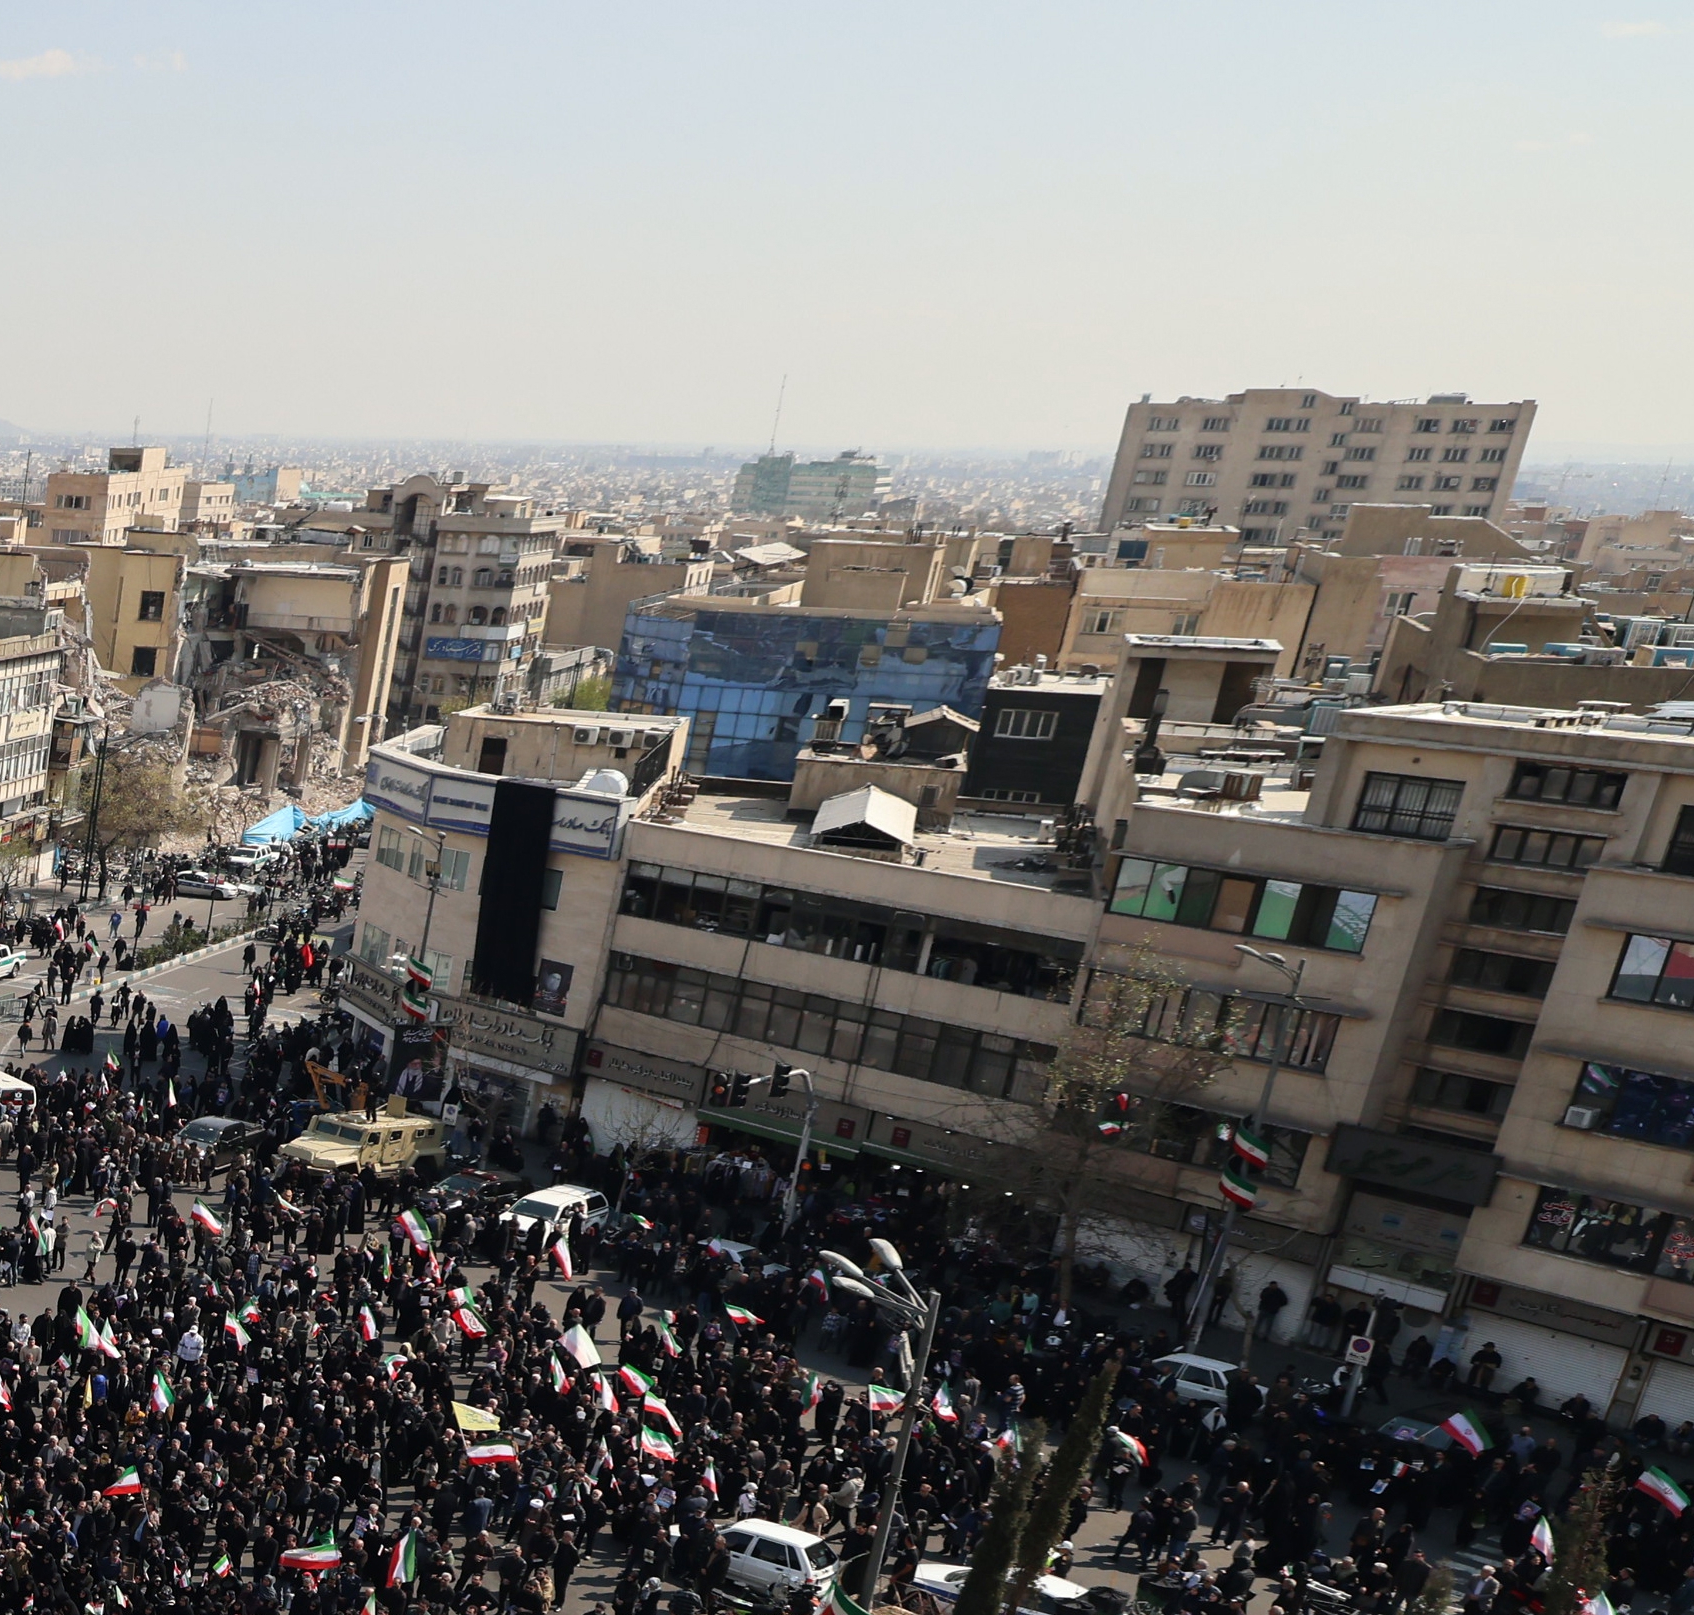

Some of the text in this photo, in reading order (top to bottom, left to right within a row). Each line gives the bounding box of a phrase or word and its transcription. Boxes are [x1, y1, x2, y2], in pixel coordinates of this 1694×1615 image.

[583, 816, 617, 841] بانک
[522, 1024, 558, 1053] بانک
[1543, 1200, 1576, 1212] عکس
[1537, 1211, 1571, 1226] فوری
[1670, 1232, 1694, 1246] وری
